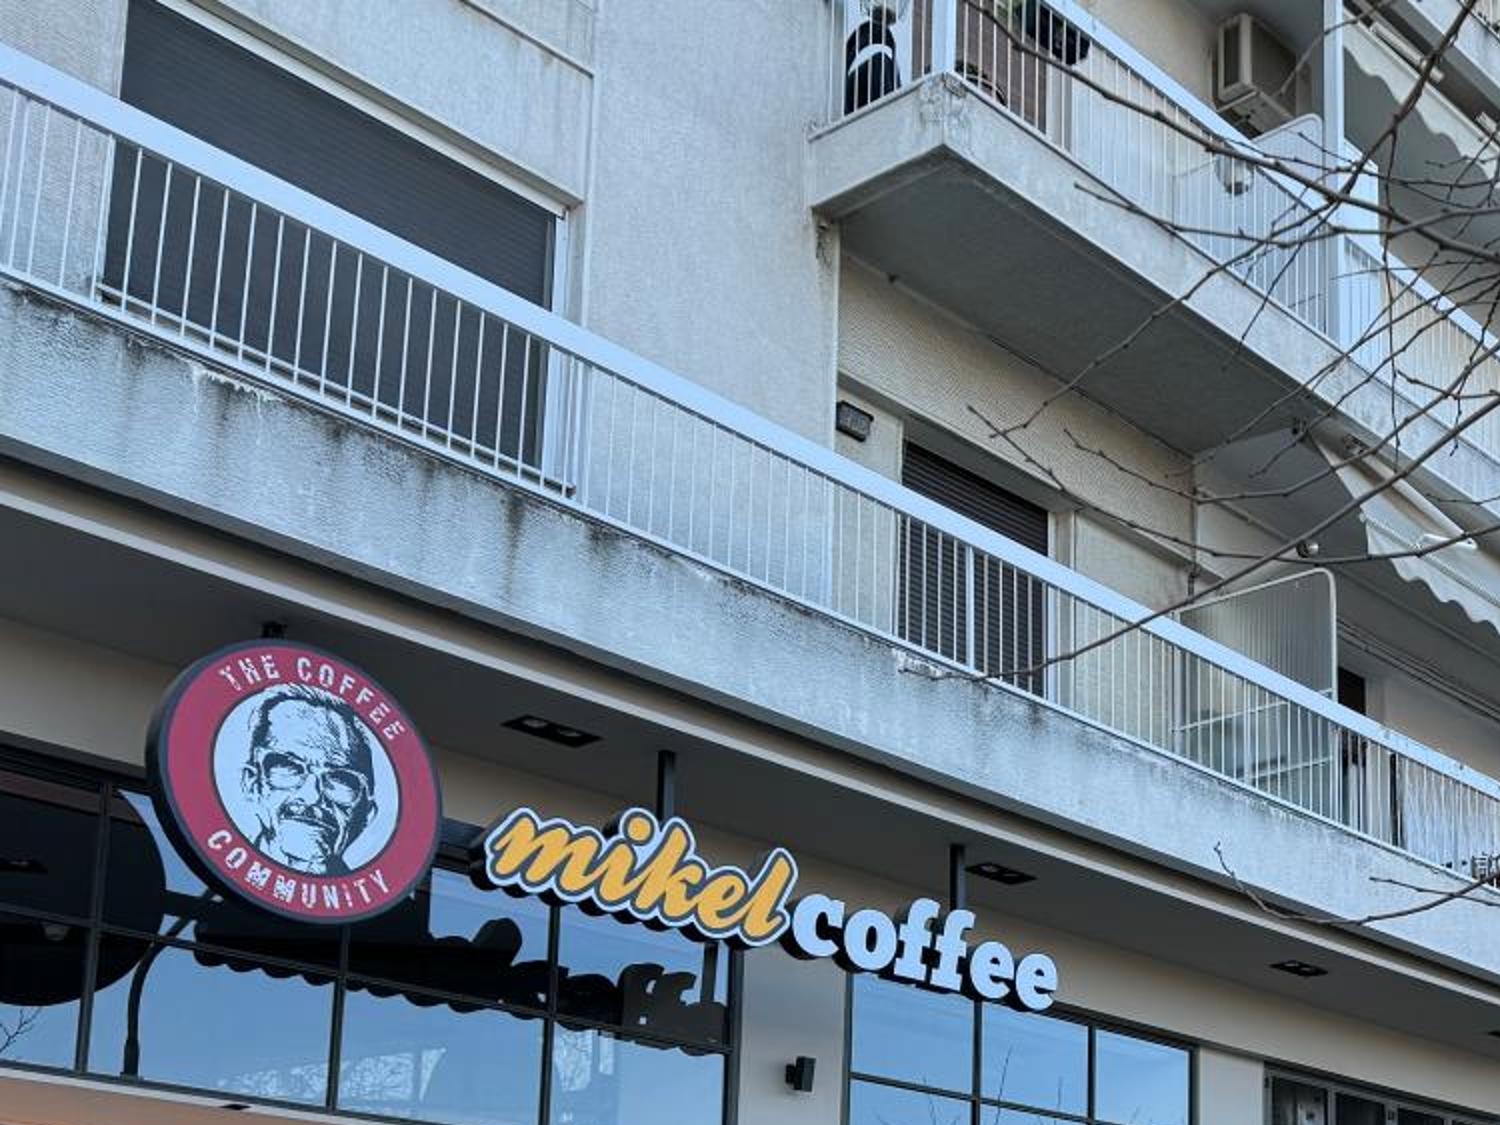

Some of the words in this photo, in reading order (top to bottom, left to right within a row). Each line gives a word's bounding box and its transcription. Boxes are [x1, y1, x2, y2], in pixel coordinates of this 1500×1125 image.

[218, 654, 281, 691] THE
[296, 656, 405, 741] COFFEE
[207, 829, 391, 910] COMMUNITY
[486, 809, 797, 945] mikel
[791, 893, 1059, 1010] coffee
